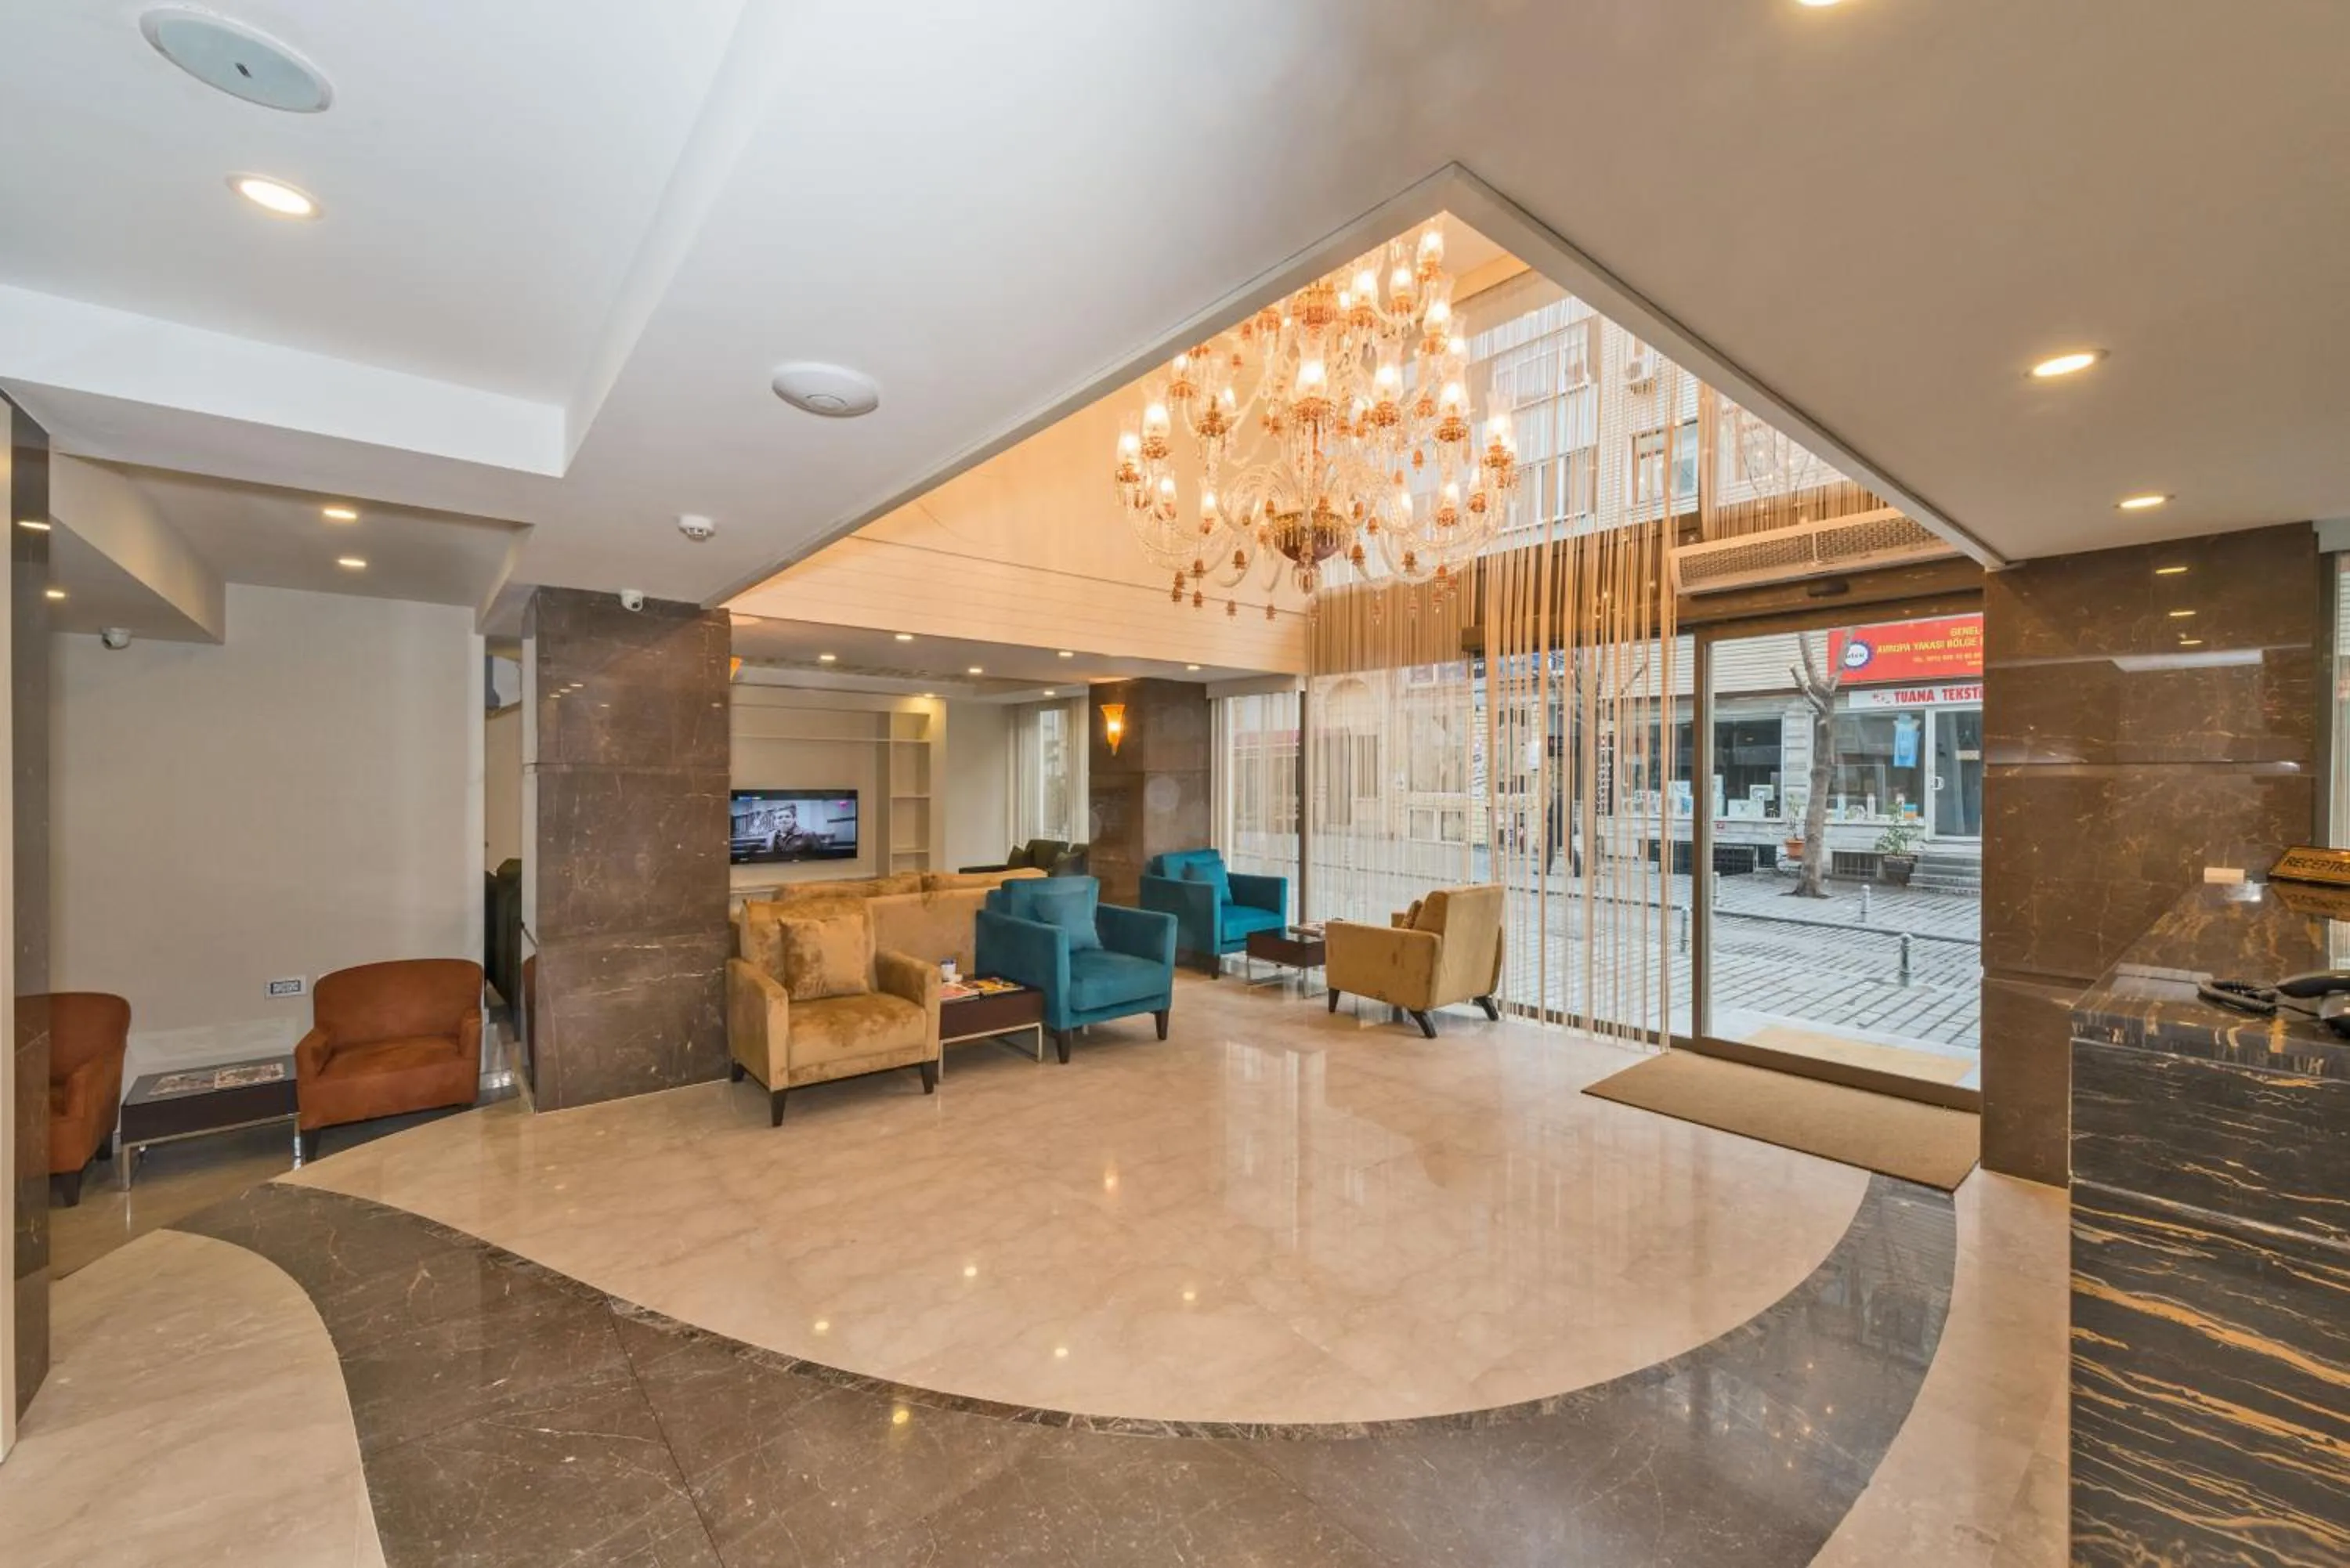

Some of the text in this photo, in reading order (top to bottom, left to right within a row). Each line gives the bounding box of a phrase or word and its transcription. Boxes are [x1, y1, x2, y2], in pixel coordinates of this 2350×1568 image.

[1877, 644, 1911, 655] AVRUPA
[1913, 640, 1945, 652] YAKASI
[1895, 689, 1935, 703] TUANA
